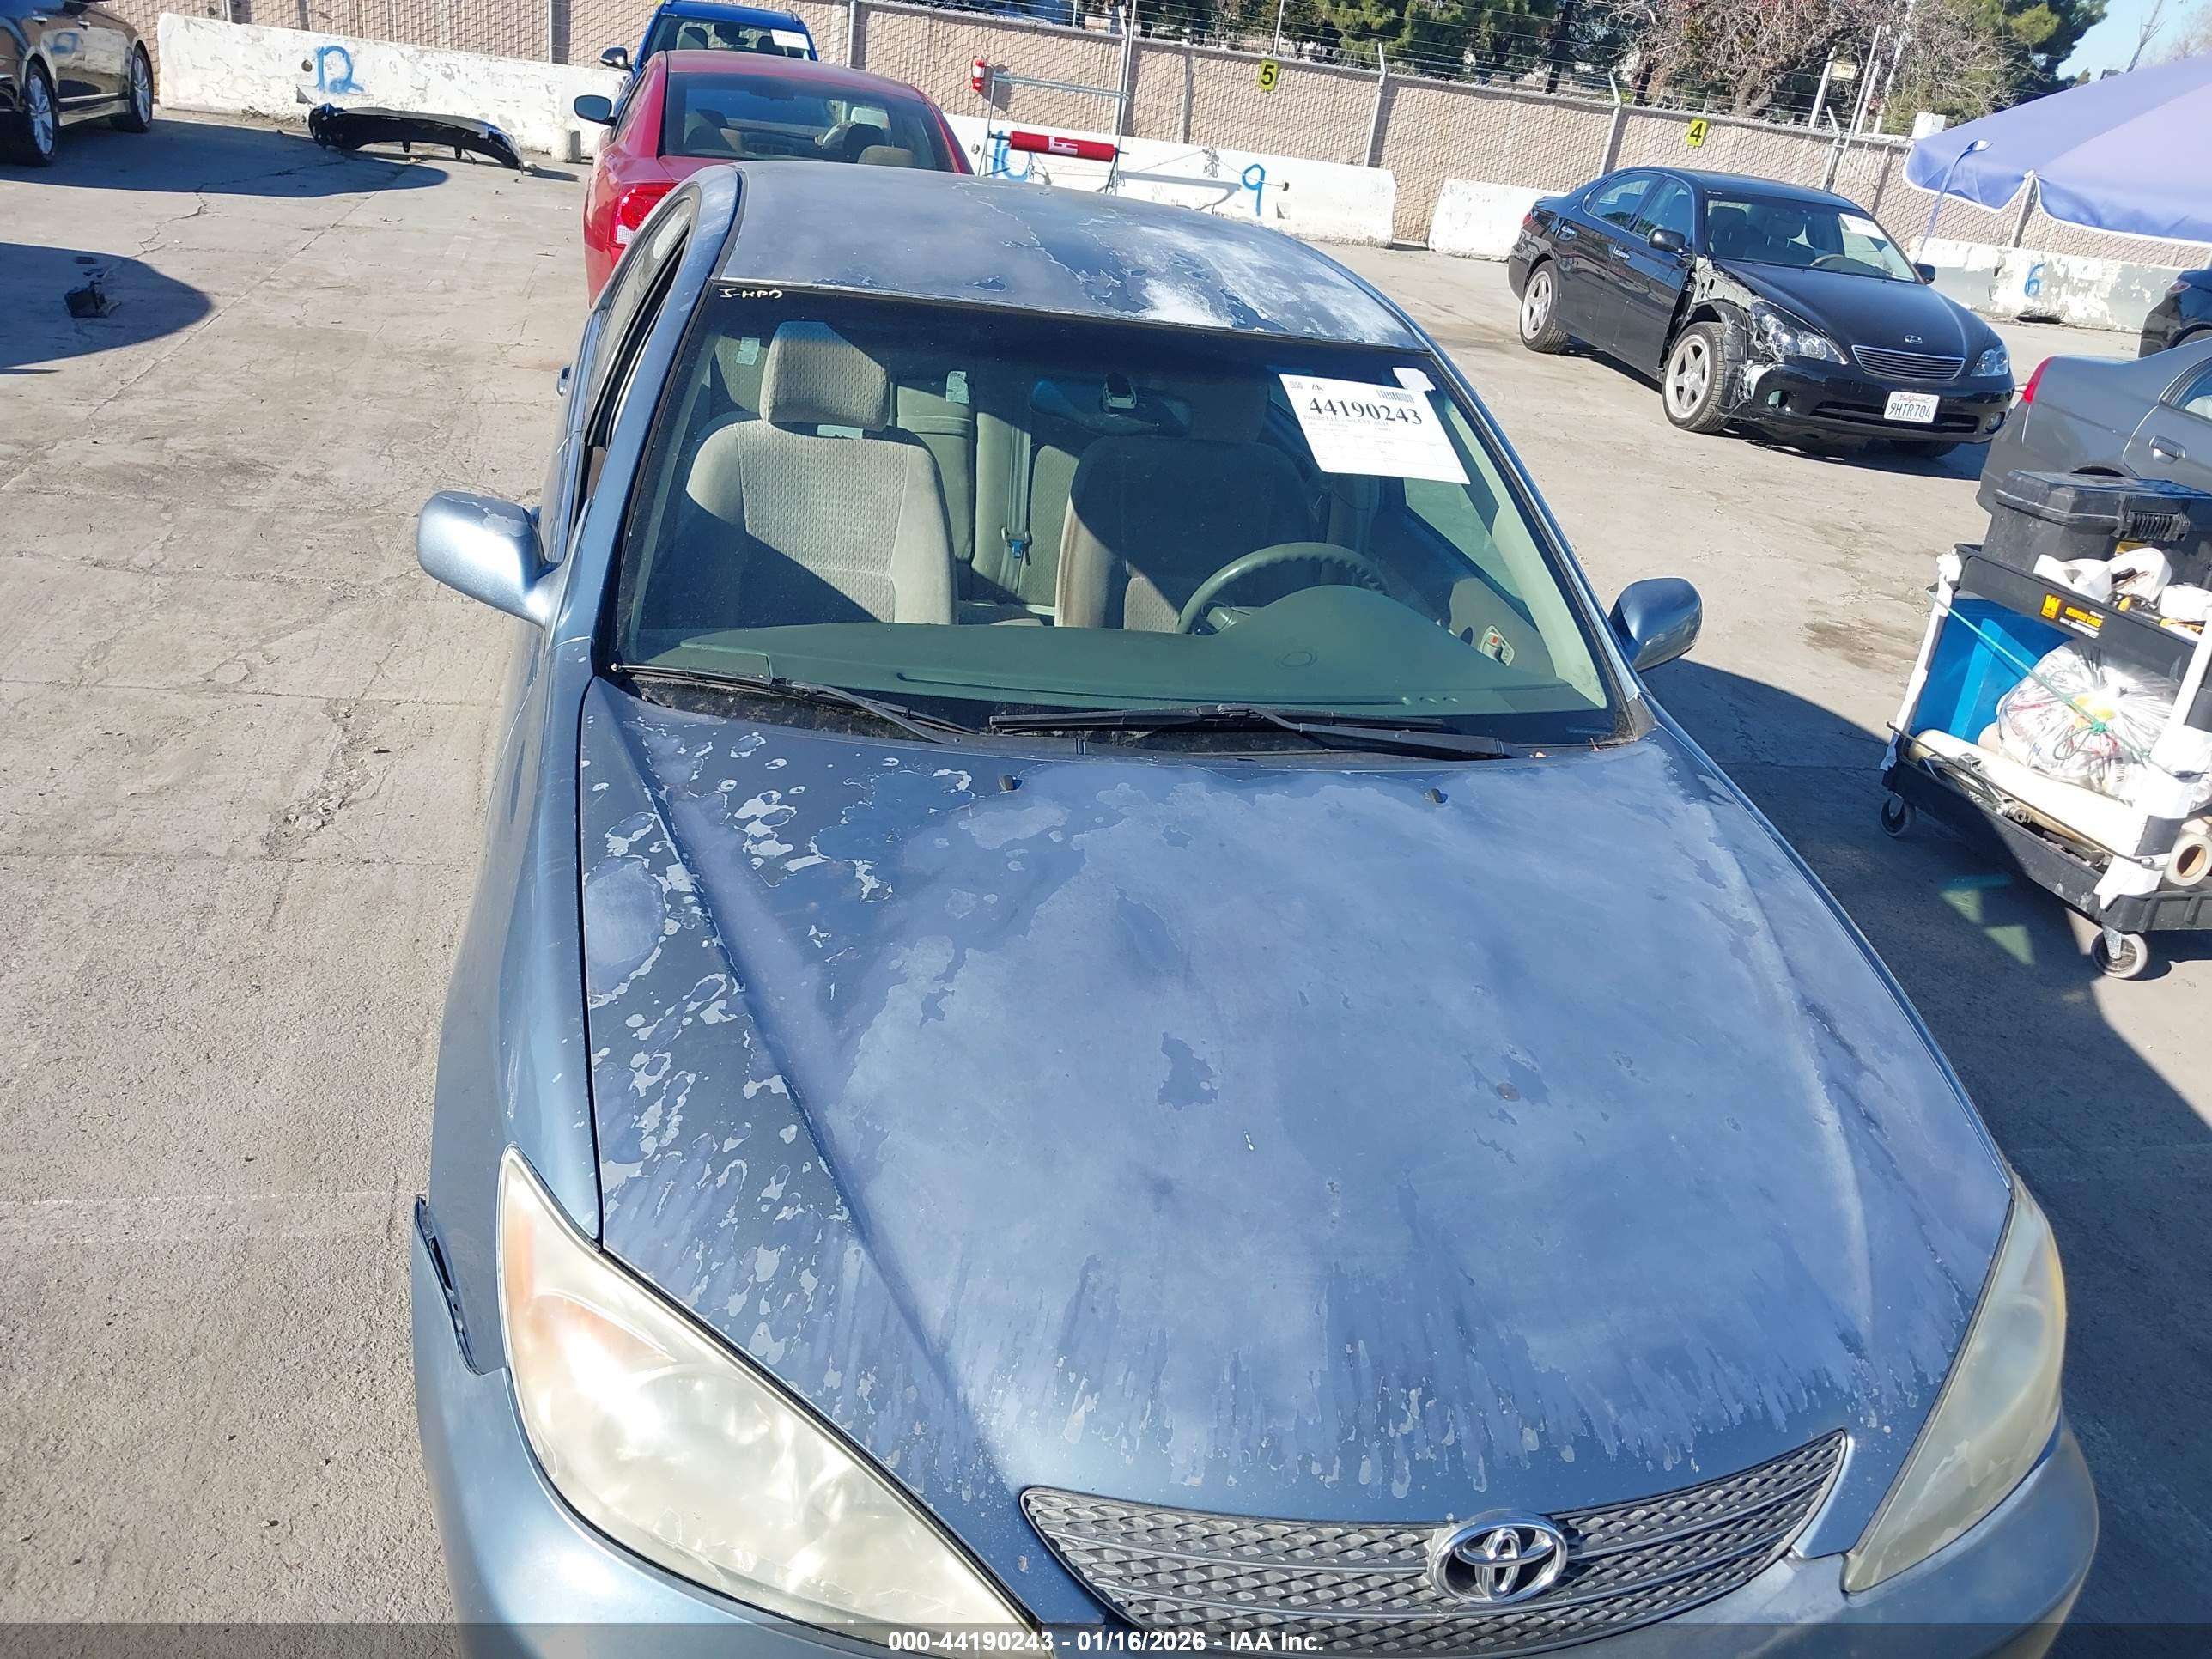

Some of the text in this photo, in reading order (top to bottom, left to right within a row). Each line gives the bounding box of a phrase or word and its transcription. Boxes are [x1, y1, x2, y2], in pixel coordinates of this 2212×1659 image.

[1261, 64, 1274, 85] 5
[1690, 122, 1703, 142] 4
[1241, 163, 1267, 216] 9
[1309, 398, 1423, 425] 44190243
[1888, 402, 1931, 418] 9HTR704
